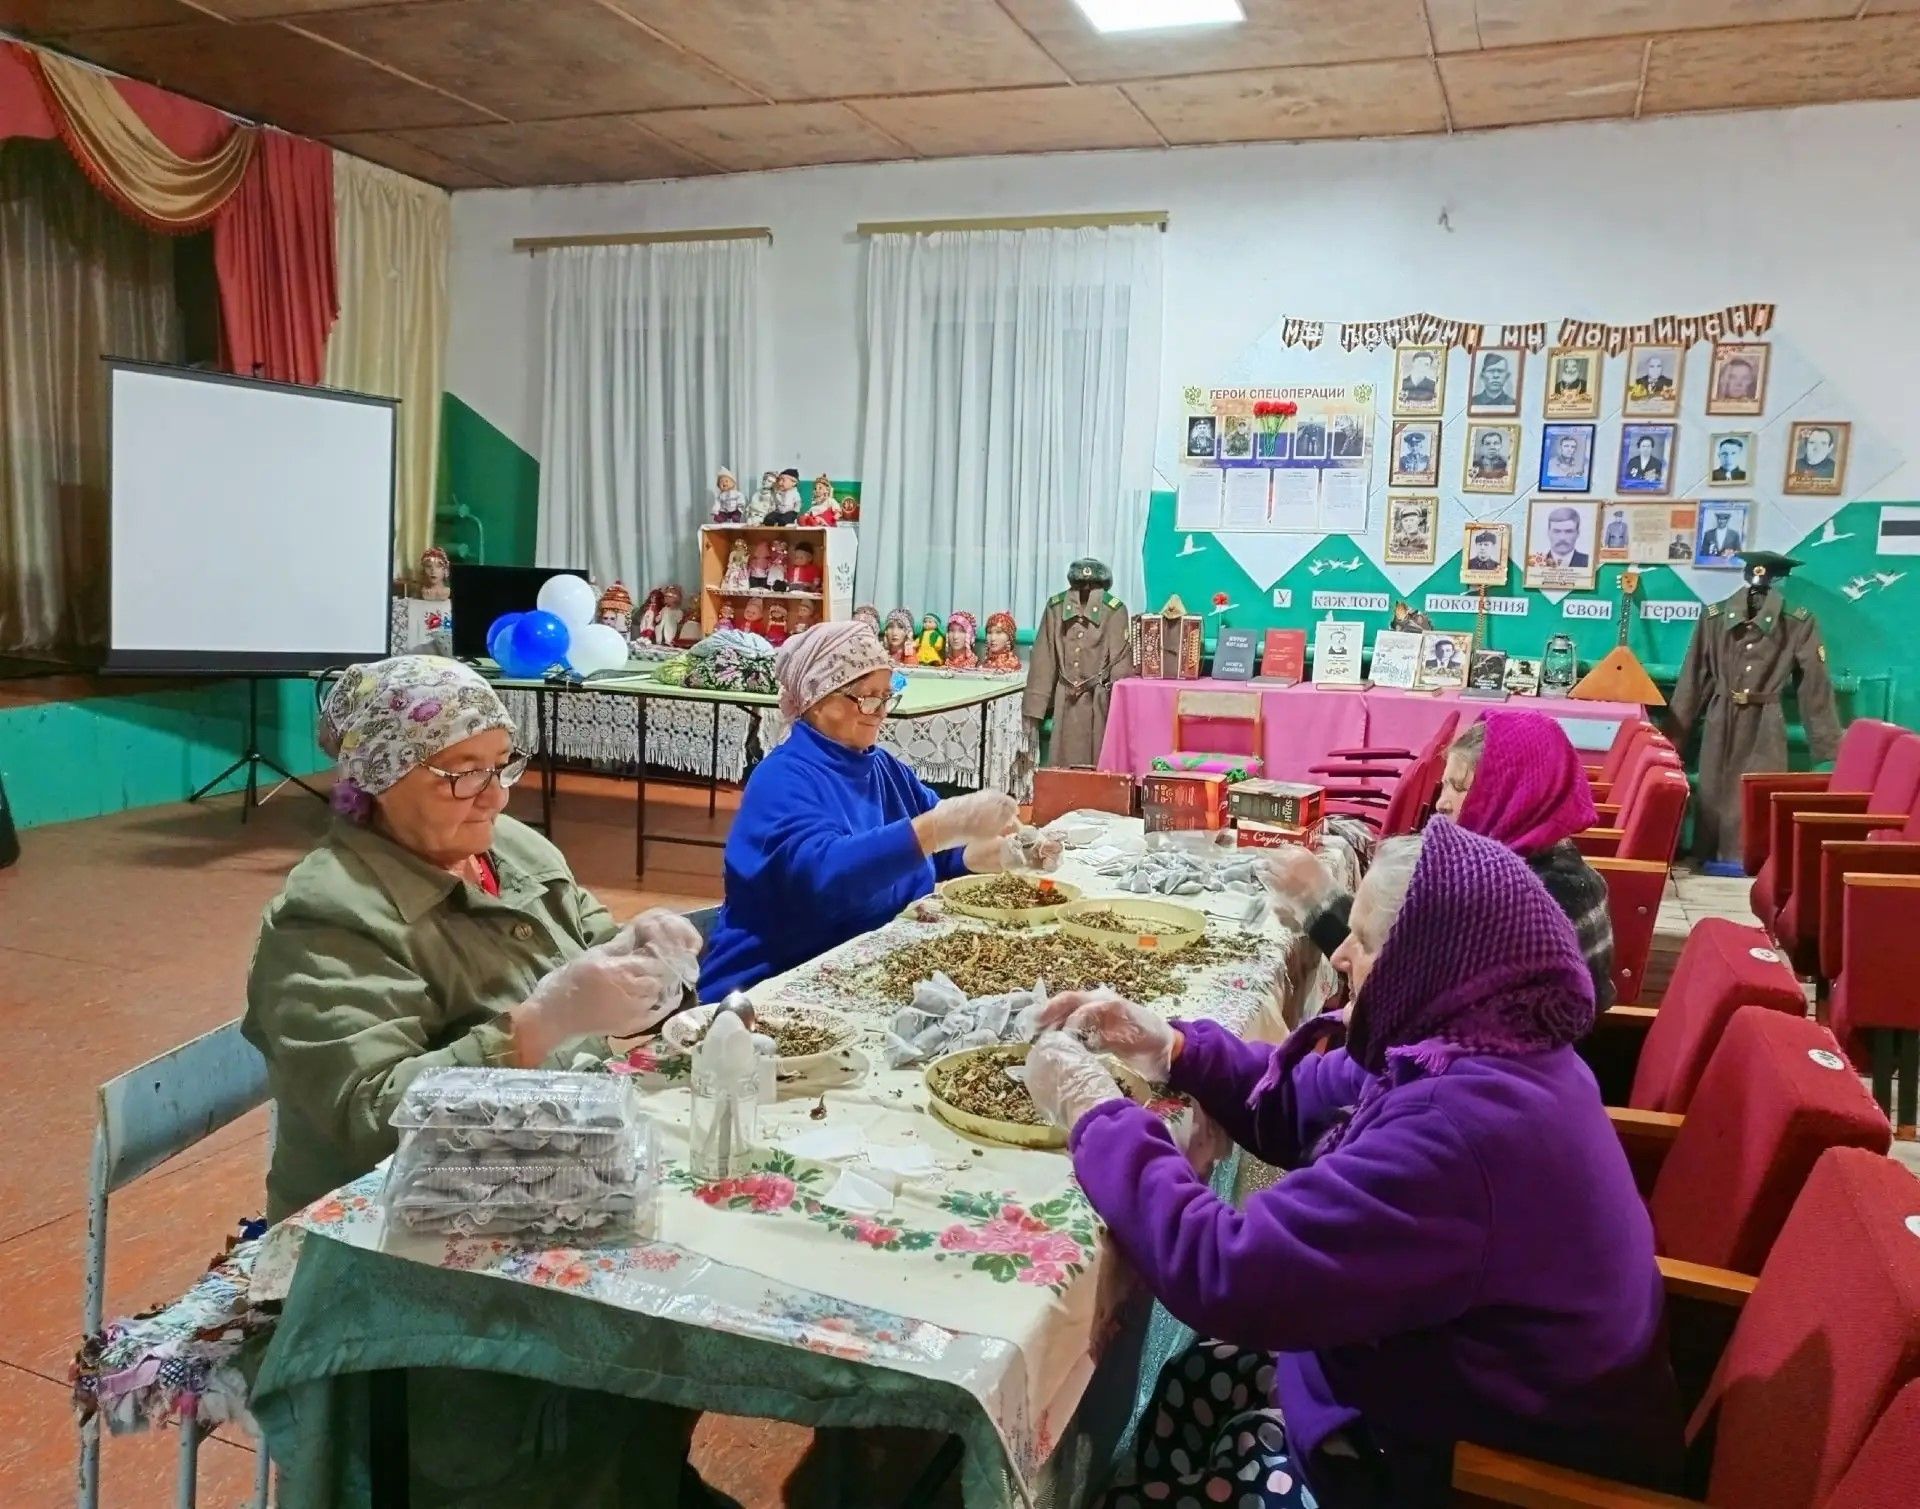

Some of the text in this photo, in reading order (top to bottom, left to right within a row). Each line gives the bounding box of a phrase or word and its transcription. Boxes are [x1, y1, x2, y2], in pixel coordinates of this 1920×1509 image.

[1285, 321, 1323, 341] МЫ
[1210, 388, 1345, 400] ГЕРОИ СПЕЦОПЕРАЦИИ
[1277, 590, 1290, 604] У
[1314, 595, 1388, 610] каждого
[1566, 603, 1609, 617] свои
[1644, 604, 1699, 621] герои
[1284, 799, 1293, 823] SHAH
[1252, 831, 1289, 847] Ceylon
